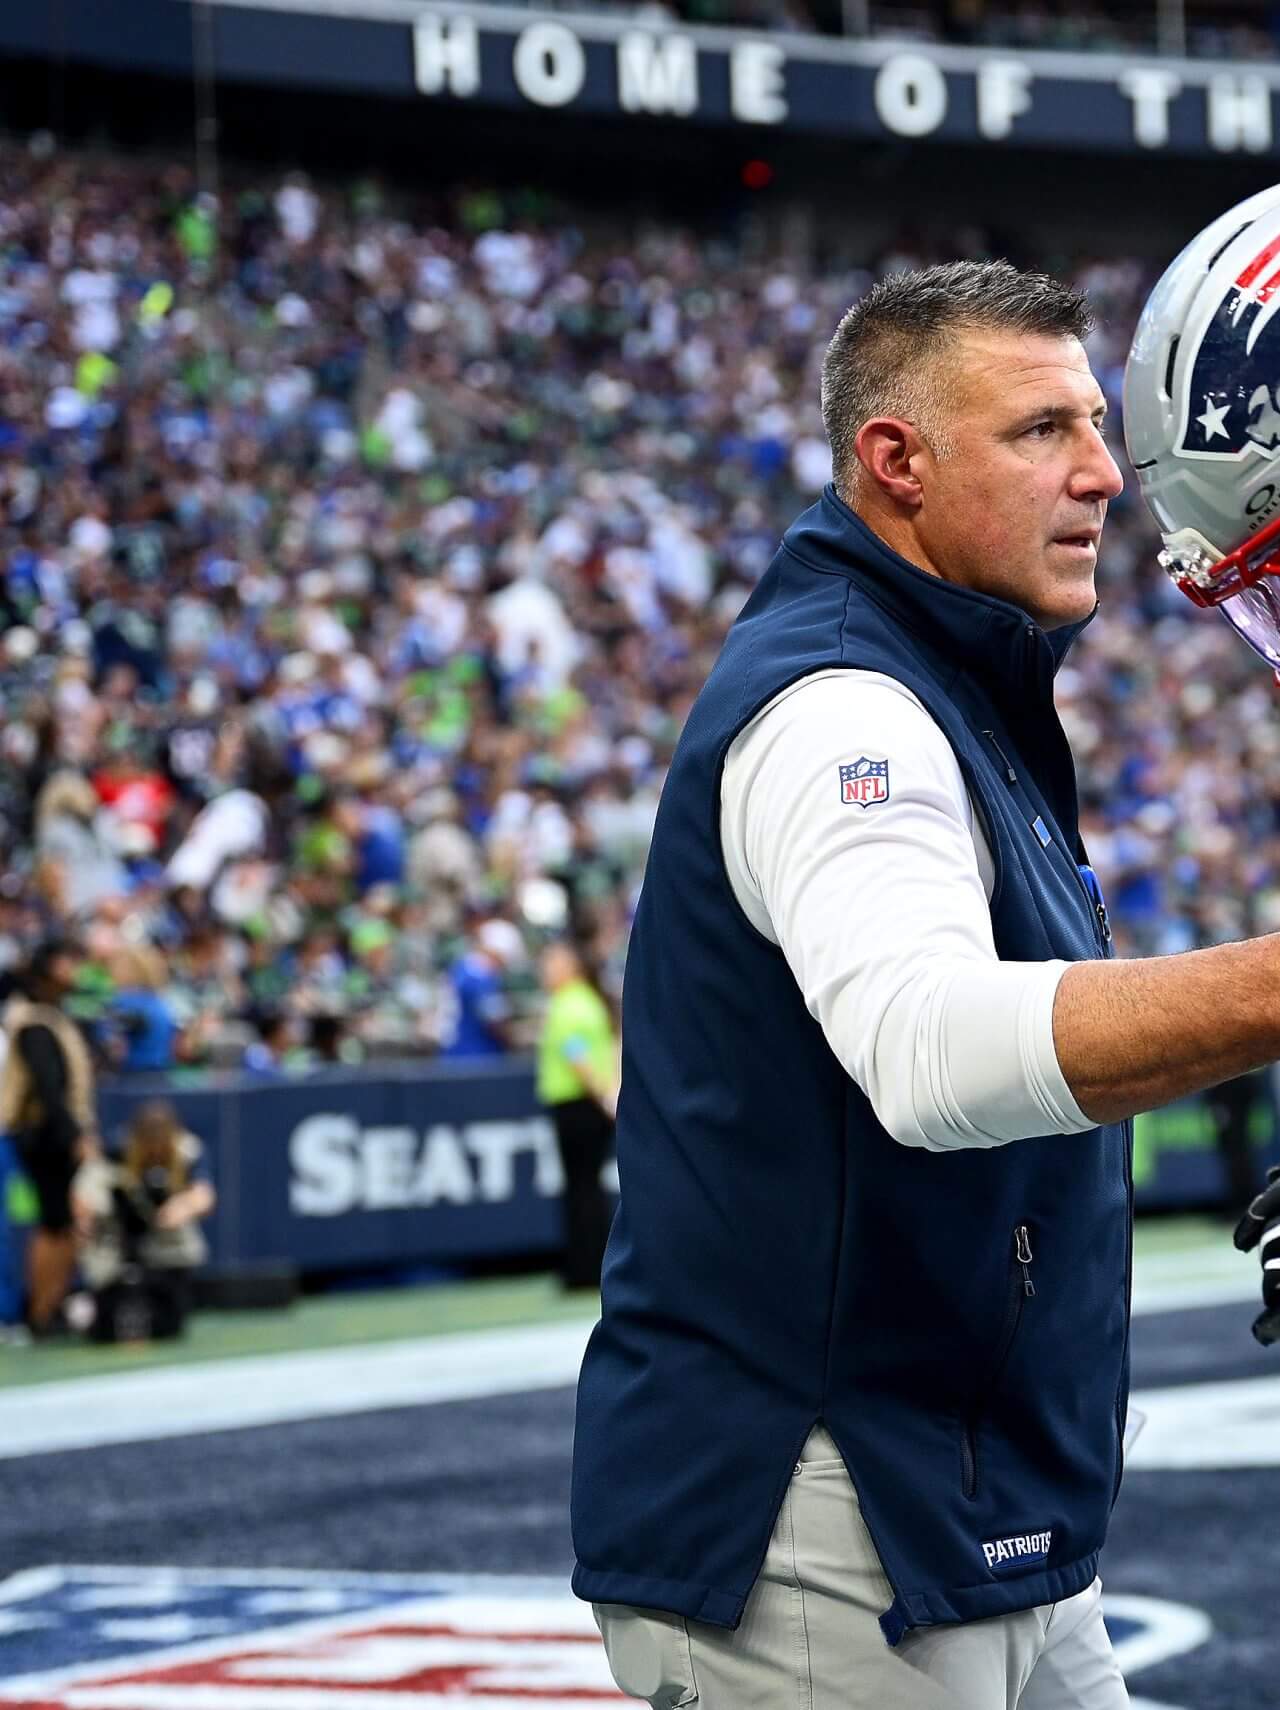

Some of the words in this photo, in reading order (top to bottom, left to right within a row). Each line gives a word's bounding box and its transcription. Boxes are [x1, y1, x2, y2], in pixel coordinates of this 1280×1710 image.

[412, 12, 788, 125] HOME
[875, 54, 1033, 140] OF
[844, 777, 885, 801] NFL
[289, 1113, 620, 1217] SEATT
[981, 1530, 1052, 1568] PATRIOTS
